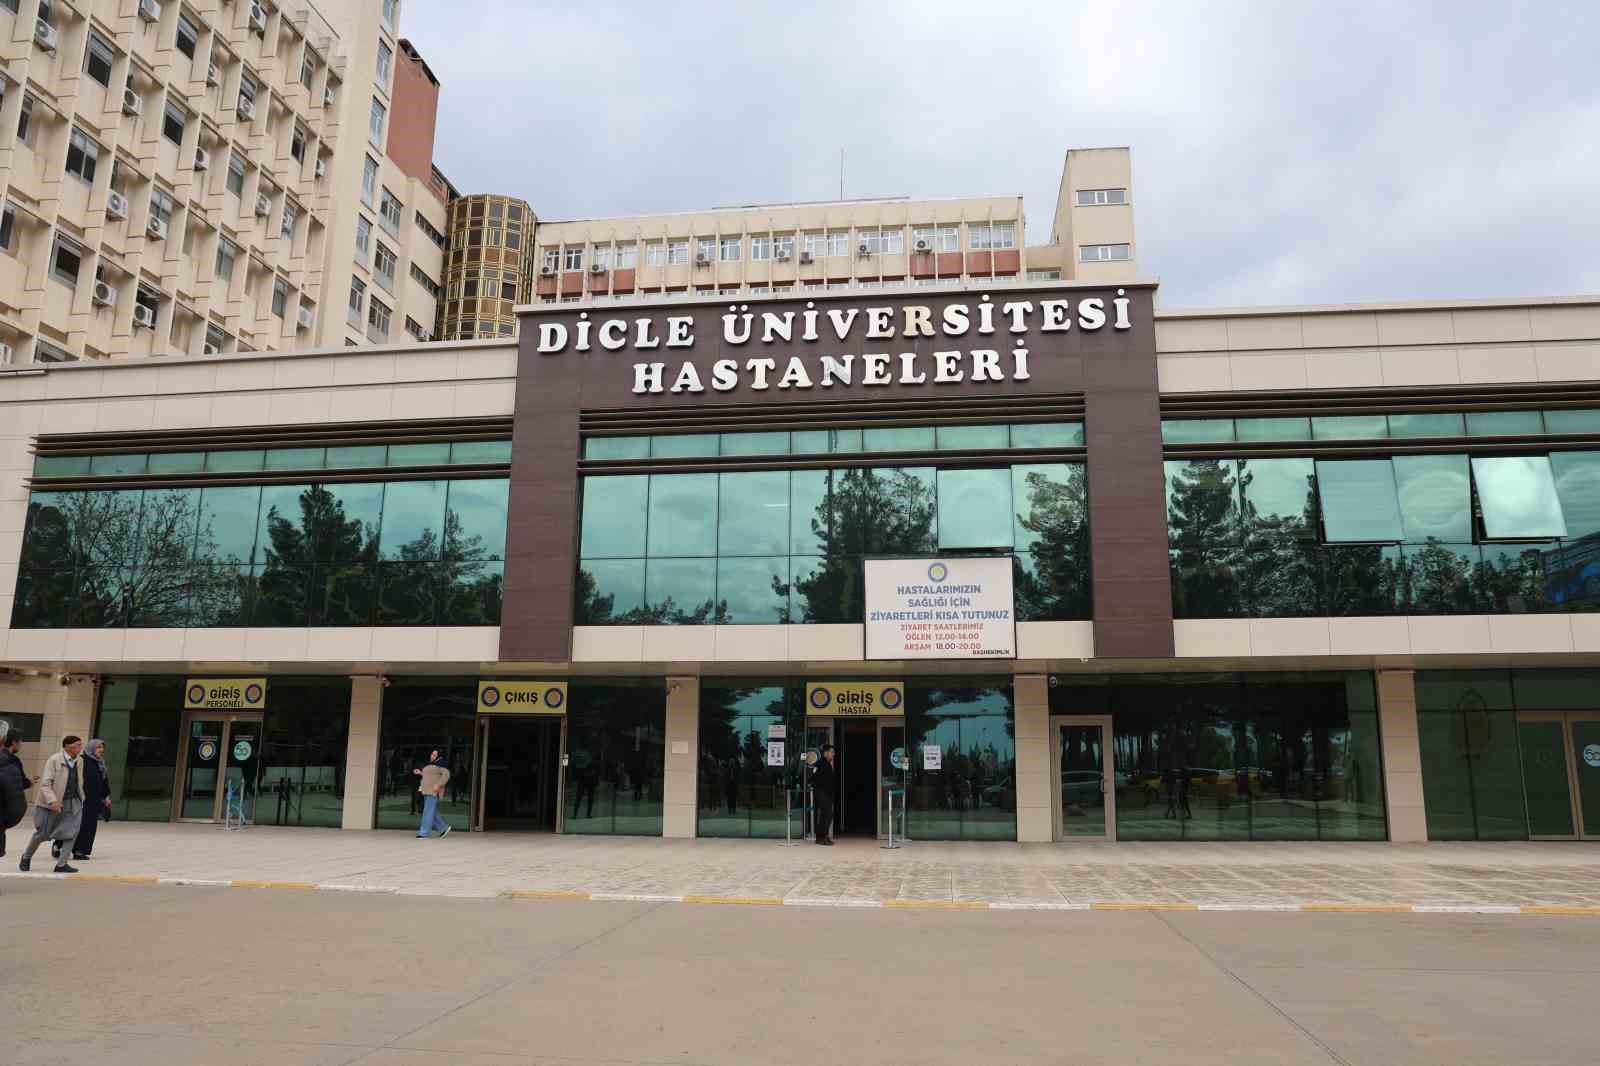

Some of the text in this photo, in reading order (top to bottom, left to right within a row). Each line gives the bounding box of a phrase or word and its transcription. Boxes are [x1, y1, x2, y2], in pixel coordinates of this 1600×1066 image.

[537, 288, 1132, 353] DİCLE ÜNİVERSİTESİ
[632, 339, 1031, 394] HASTANELERİ
[870, 610, 1009, 621] ZİYARETLERİ KISA TUTUNUZ
[210, 686, 241, 702] GİRİŞ
[504, 691, 539, 705] ÇIKIŞ
[836, 690, 874, 706] GİRİŞ
